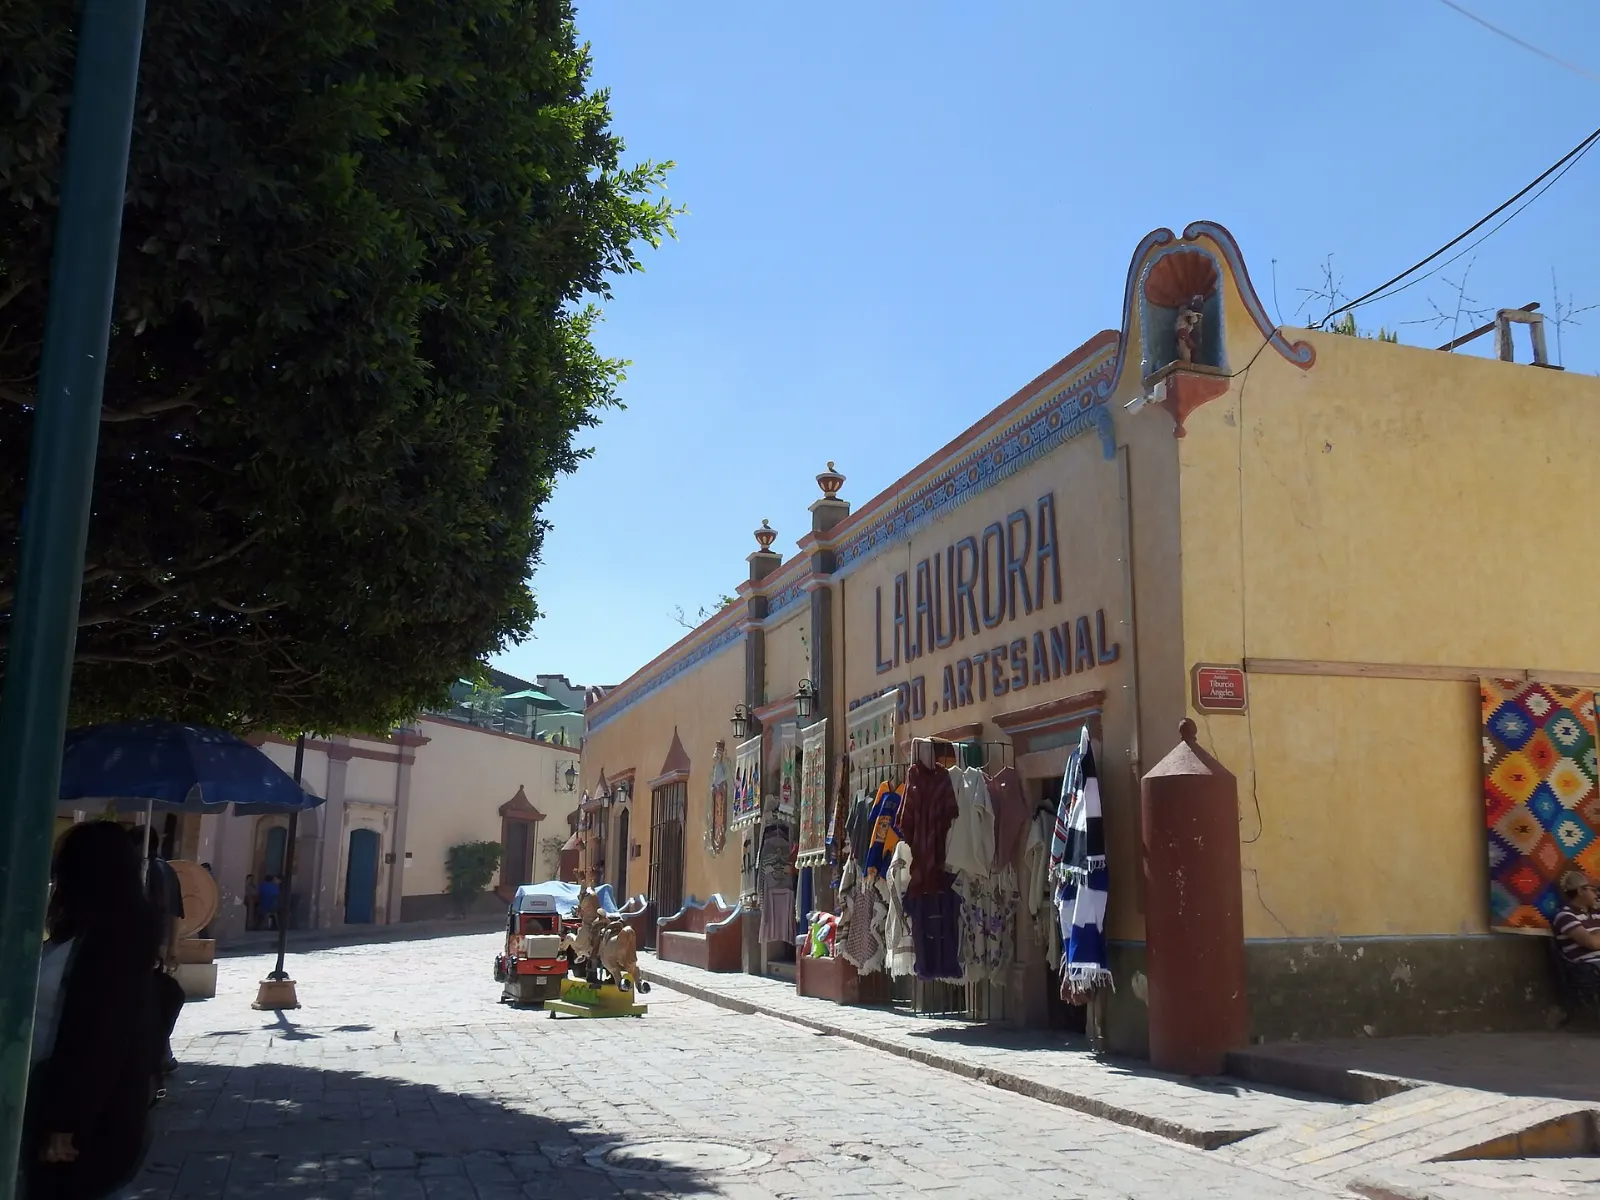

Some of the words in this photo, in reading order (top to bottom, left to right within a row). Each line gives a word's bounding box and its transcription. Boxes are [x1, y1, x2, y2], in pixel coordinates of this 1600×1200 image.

[916, 491, 1062, 659] AURORA
[942, 608, 1120, 713] ARTESANAL
[1209, 679, 1234, 688] Tiburcio
